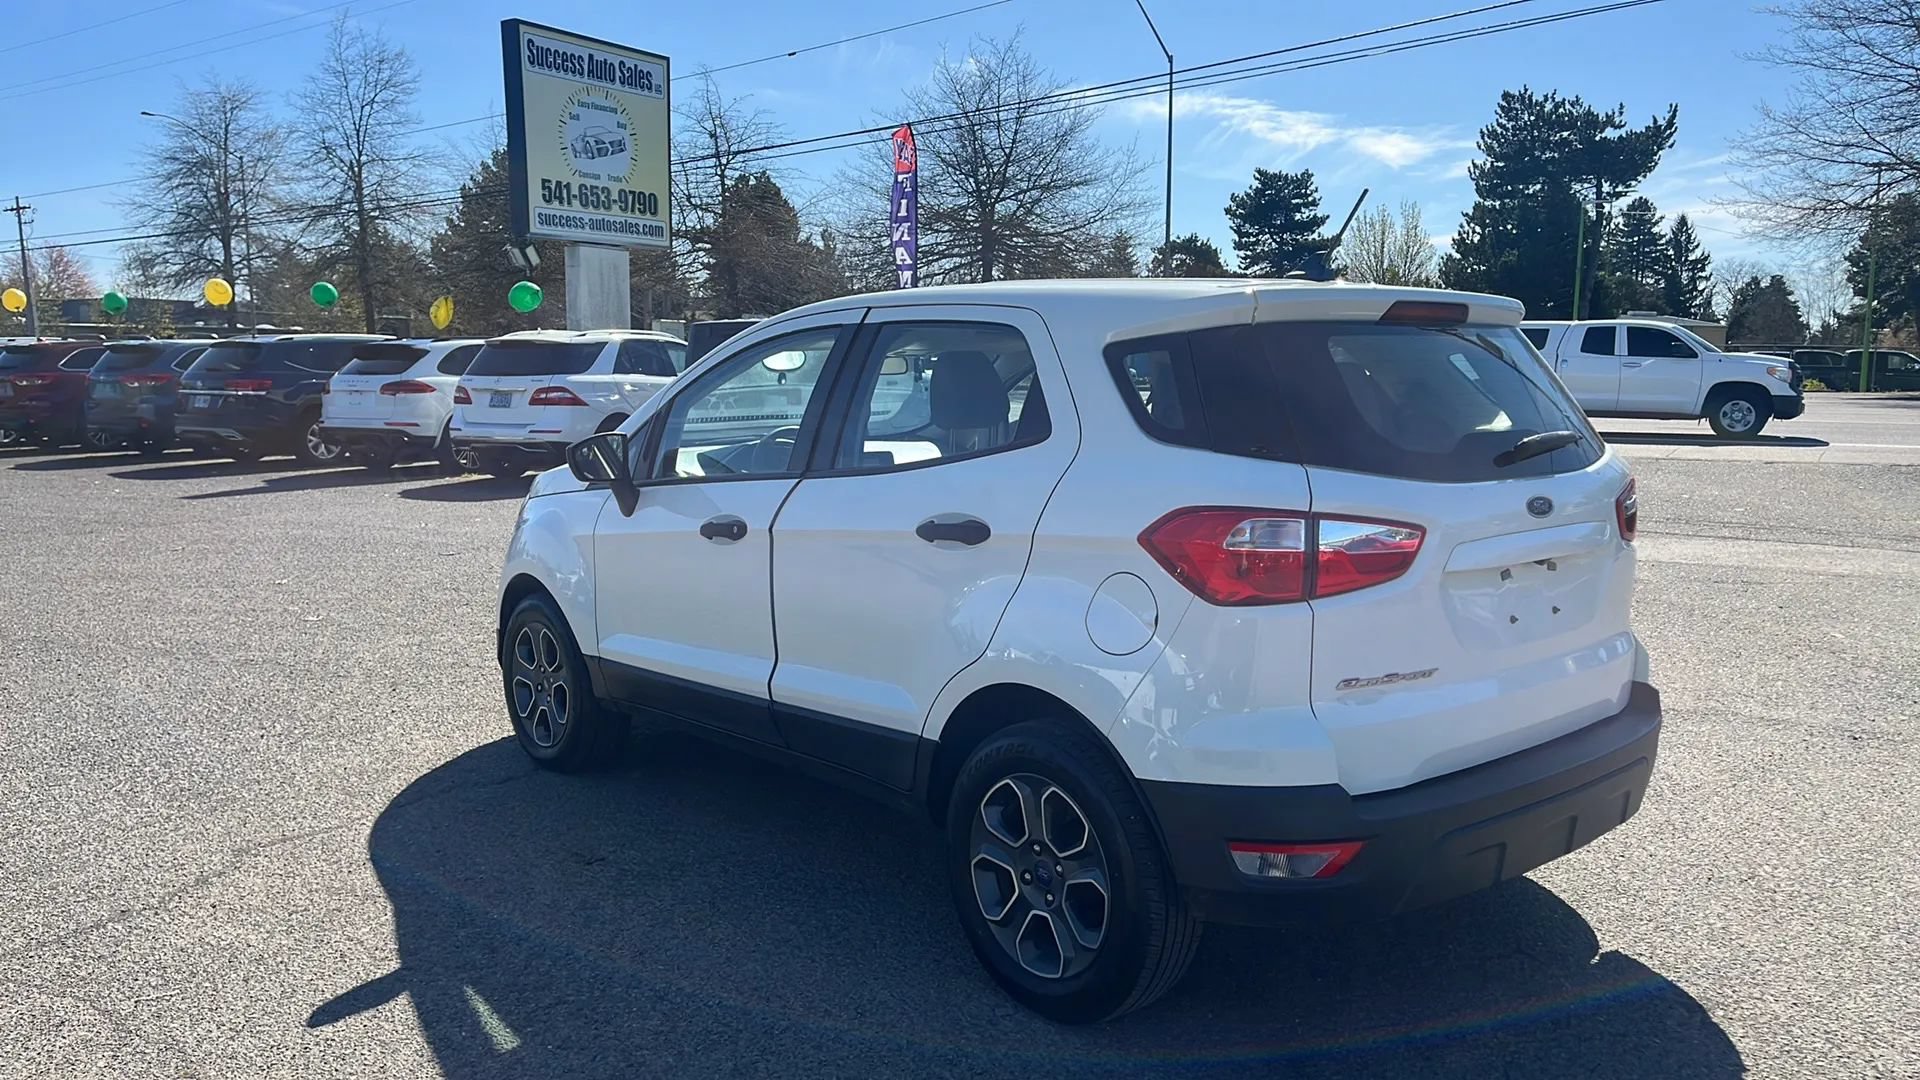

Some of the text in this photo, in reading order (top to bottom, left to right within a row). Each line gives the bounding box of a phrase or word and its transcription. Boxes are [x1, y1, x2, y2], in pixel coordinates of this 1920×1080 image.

[526, 38, 653, 93] Success Auto Sales
[569, 112, 580, 121] Sell
[577, 99, 618, 115] Easy Financing
[540, 178, 659, 217] 541-653-9790
[537, 211, 665, 239] success-autosales.com
